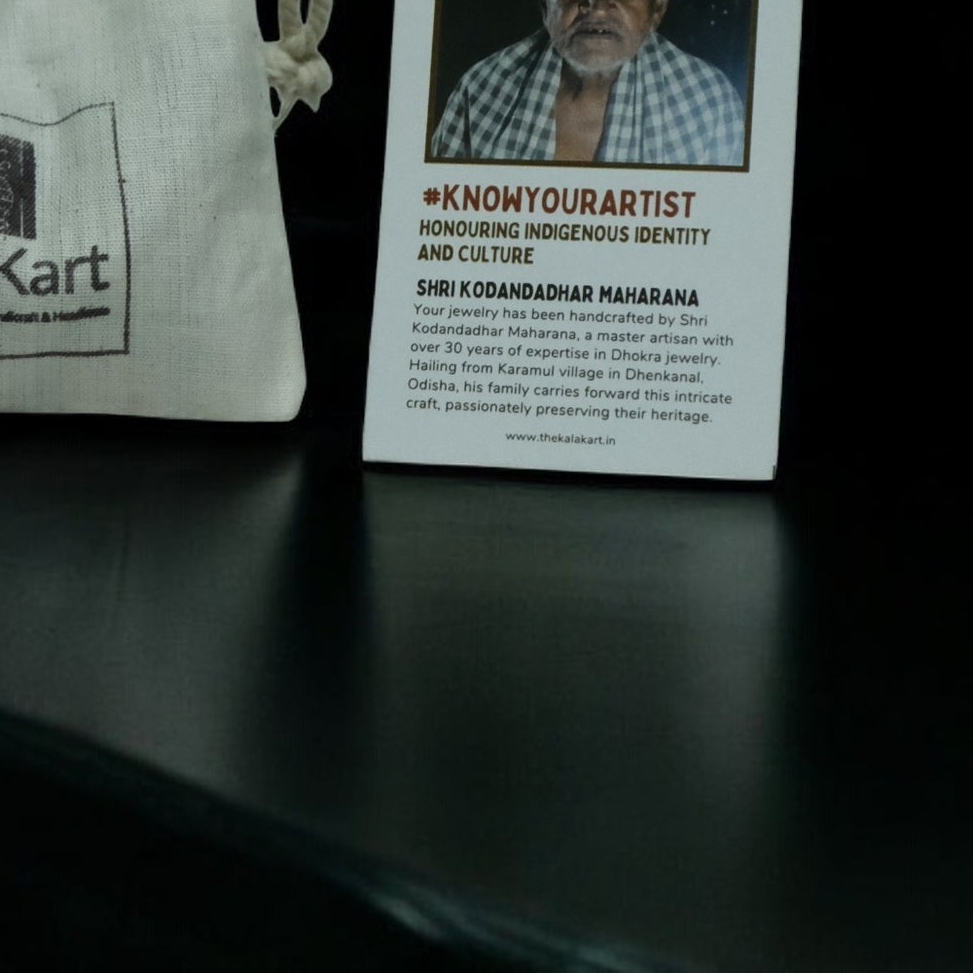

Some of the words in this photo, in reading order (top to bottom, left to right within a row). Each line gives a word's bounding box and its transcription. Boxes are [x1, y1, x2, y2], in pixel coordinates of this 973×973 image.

[422, 183, 697, 219] #KNOWYOURARTIST
[419, 218, 520, 239] HONOURING
[524, 222, 629, 243] INDIGENOUS
[634, 225, 711, 246] IDENTITY
[416, 243, 454, 261] AND
[457, 244, 535, 265] CULTURE
[416, 278, 456, 298] SHRI
[459, 280, 594, 303] KODANDADHAR
[598, 284, 699, 307] MAHARANA
[413, 302, 446, 316] Your
[447, 304, 499, 321] jewelry
[502, 306, 527, 320] has
[531, 307, 565, 321] been
[569, 309, 654, 325] handcrafted
[658, 312, 676, 328] by
[679, 313, 708, 326] Shri
[411, 321, 504, 337] Kodandadhar
[507, 325, 580, 342] Maharana,
[584, 331, 592, 341] a
[596, 331, 646, 343] master
[649, 332, 698, 345] artisan
[701, 333, 734, 347] with
[410, 342, 441, 353] over
[443, 340, 463, 354] 30
[466, 345, 504, 357] years
[507, 344, 522, 357] of
[525, 346, 590, 360] expertise
[593, 347, 606, 360] in
[610, 347, 662, 363] Dhokra
[664, 350, 721, 367] jewelry.
[408, 358, 457, 375] Hailing
[461, 360, 493, 374] from
[497, 362, 555, 377] Karamul
[558, 365, 604, 382] village
[608, 367, 621, 380] in
[625, 367, 704, 384] Dhenkanal,
[407, 377, 459, 394] Odisha,
[463, 380, 483, 393] his
[487, 381, 530, 398] family
[533, 384, 580, 398] carries
[584, 385, 640, 401] forward
[643, 388, 670, 402] this
[674, 389, 733, 405] intricate
[405, 397, 441, 411] craft,
[444, 399, 532, 416] passionately
[535, 404, 610, 421] preserving
[614, 406, 647, 420] their
[650, 407, 712, 425] heritage.
[505, 432, 616, 446] www.thekalakart.in
